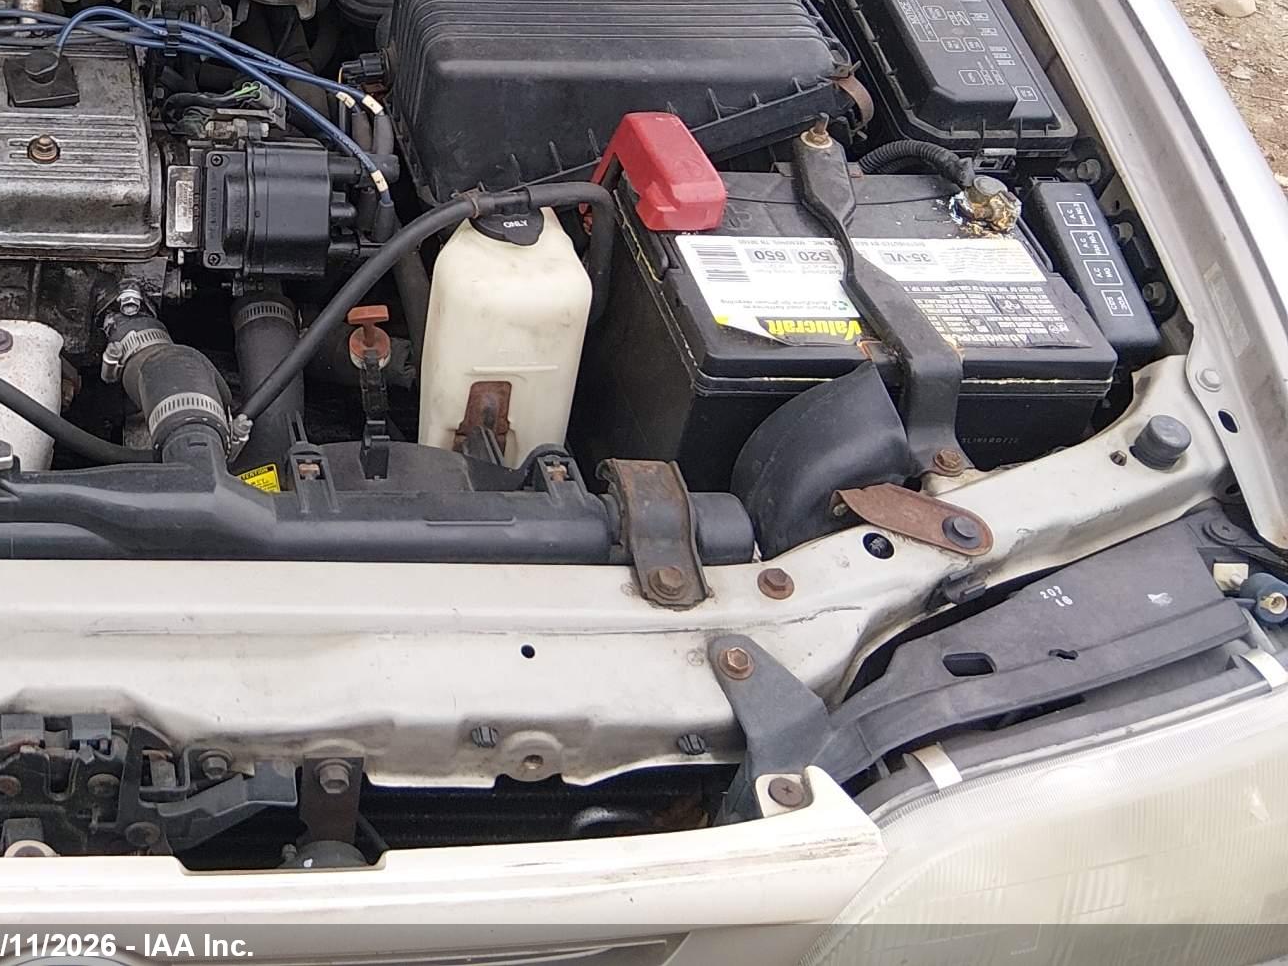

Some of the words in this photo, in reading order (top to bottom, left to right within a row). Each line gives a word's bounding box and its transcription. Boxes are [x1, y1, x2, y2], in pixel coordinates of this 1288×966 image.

[503, 219, 528, 228] ONLY
[754, 250, 785, 261] 650
[798, 250, 830, 262] 520
[884, 251, 932, 263] 35-VL
[767, 319, 862, 340] Valucraft
